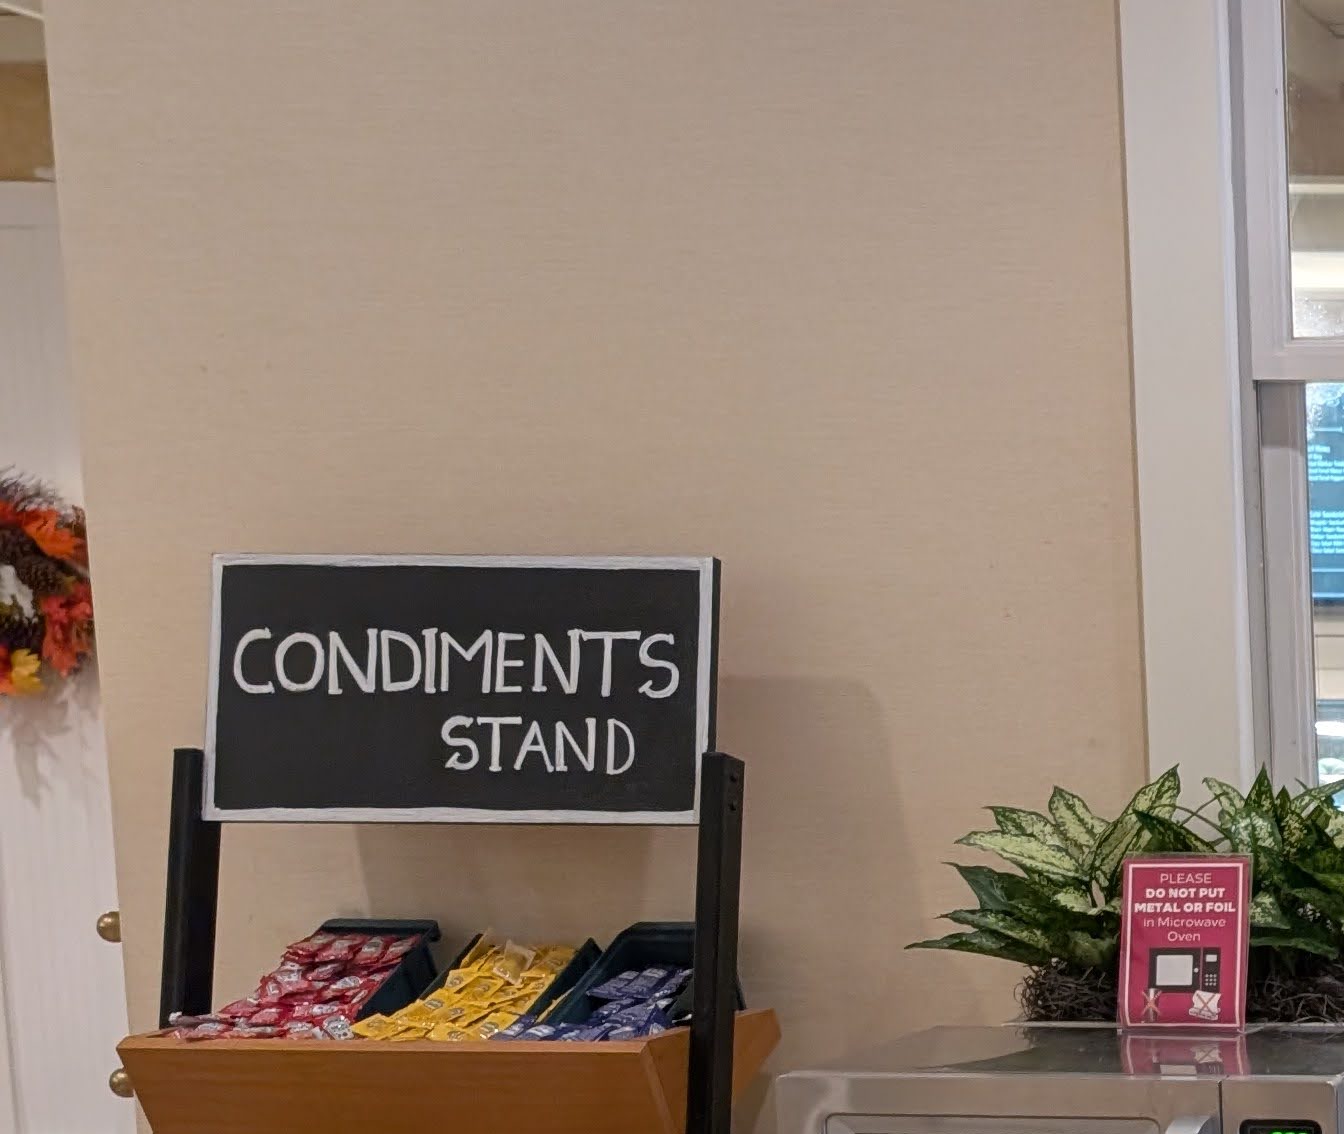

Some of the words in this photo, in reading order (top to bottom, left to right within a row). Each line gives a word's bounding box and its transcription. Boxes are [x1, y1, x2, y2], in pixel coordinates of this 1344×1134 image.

[233, 627, 680, 699] CONDIMENTS
[440, 716, 635, 775] STAND
[1160, 873, 1212, 884] PLEASE
[1146, 888, 1166, 899] DO
[1168, 888, 1196, 899] NOT
[1200, 888, 1225, 898] PUT
[1134, 903, 1180, 913] METAL
[1183, 903, 1202, 912] OR
[1205, 903, 1236, 912] FOIL
[1158, 916, 1226, 928] Microwave
[1167, 931, 1201, 942] Oven
